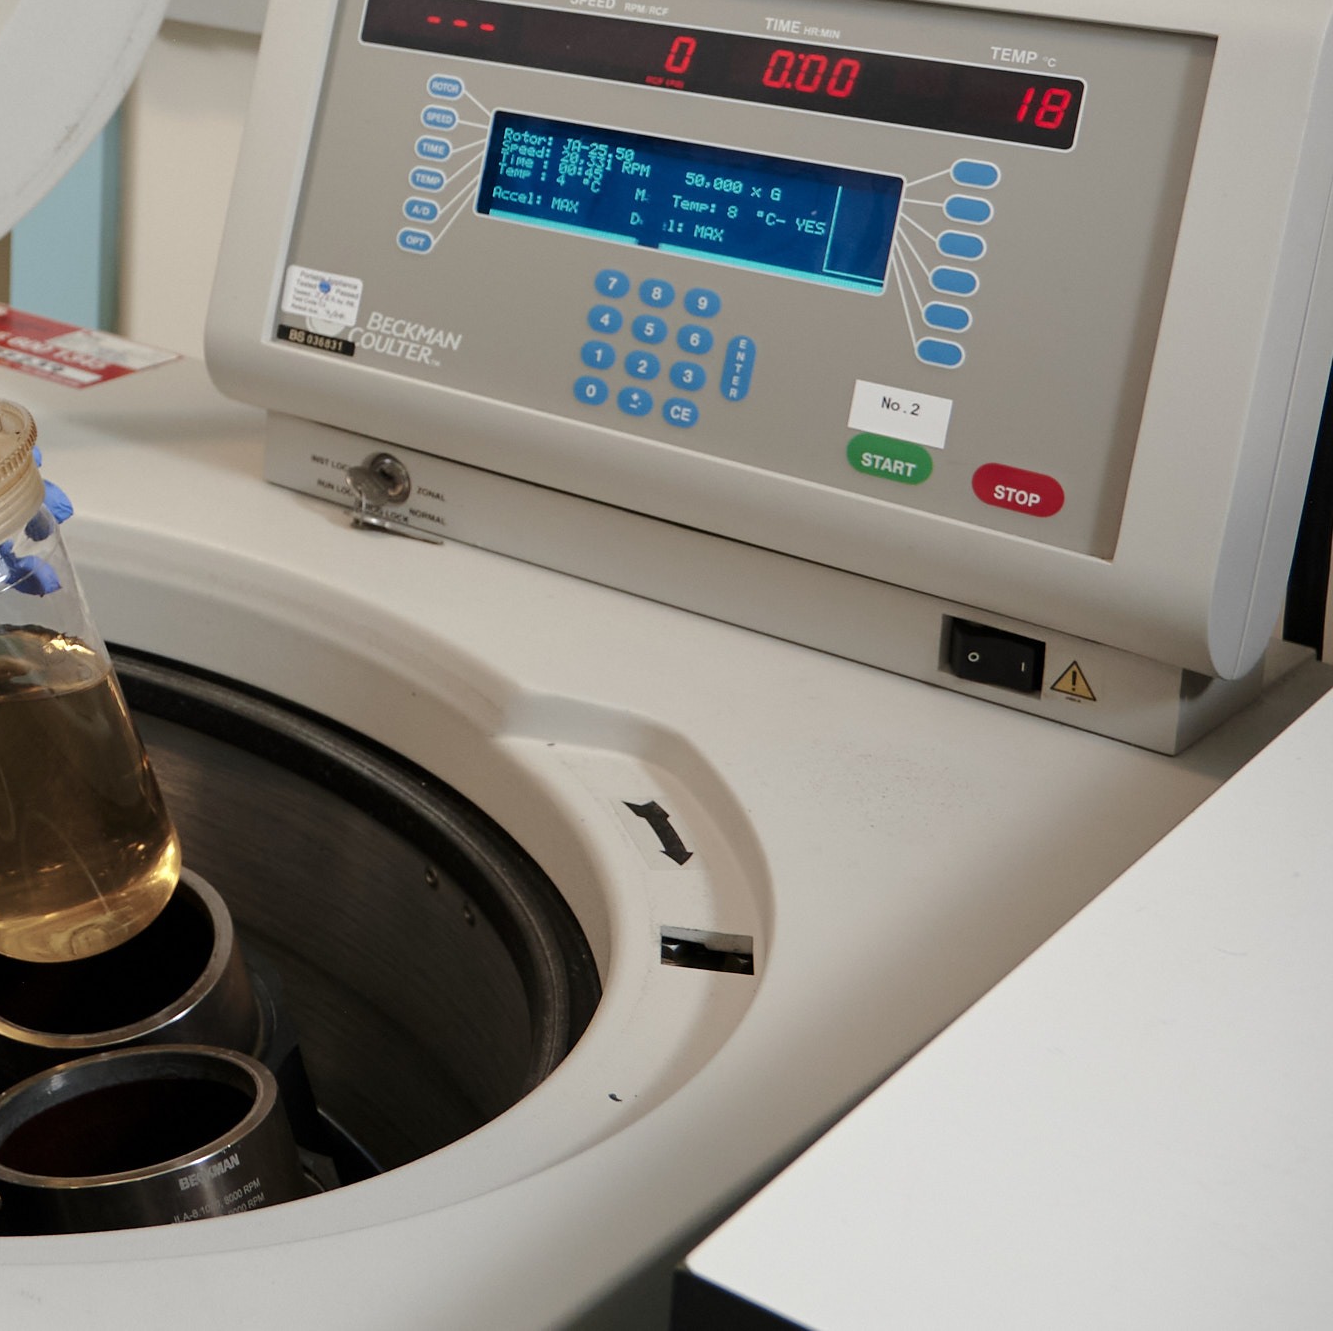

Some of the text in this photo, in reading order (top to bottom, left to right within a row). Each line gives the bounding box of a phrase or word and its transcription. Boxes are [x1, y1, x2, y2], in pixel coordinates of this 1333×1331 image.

[624, 2, 670, 17] RPM/RCF
[764, 17, 801, 34] TIME
[665, 36, 696, 75] 0
[990, 46, 1038, 65] TEMP
[431, 80, 459, 94] ROTOR
[1016, 87, 1073, 131] 18
[425, 111, 453, 125] SPEED
[503, 127, 554, 147] Rotor:
[421, 142, 445, 155] TIME
[502, 140, 551, 159] Speed:
[621, 161, 651, 178] RPM
[685, 172, 743, 195] 50,000
[415, 172, 441, 186] TEMP
[492, 185, 580, 214] Accel: MAX
[412, 204, 430, 216] A/D
[671, 194, 717, 214] Temp:
[795, 217, 827, 236] YES
[693, 223, 724, 242] MAX
[405, 234, 425, 247] OPT
[608, 277, 618, 290] 7
[651, 286, 663, 300] 8
[697, 296, 708, 310] 9
[599, 313, 611, 326] 4
[288, 329, 305, 343] BS
[366, 311, 463, 351] BECKMAN
[643, 322, 655, 336] 5
[348, 326, 432, 366] COULTER
[689, 333, 700, 347] 6
[595, 348, 603, 362] 1
[637, 359, 648, 374] 2
[728, 338, 748, 399] ENTER
[682, 369, 694, 383] 3
[585, 384, 597, 398] 0
[669, 405, 692, 421] CE
[331, 460, 350, 471] LOC
[860, 452, 917, 478] START
[416, 485, 446, 502] ZONAL
[992, 484, 1041, 508] STOP
[409, 507, 446, 526] NORMAL
[178, 1152, 241, 1191] BECKMAN
[243, 1177, 261, 1194] RPM
